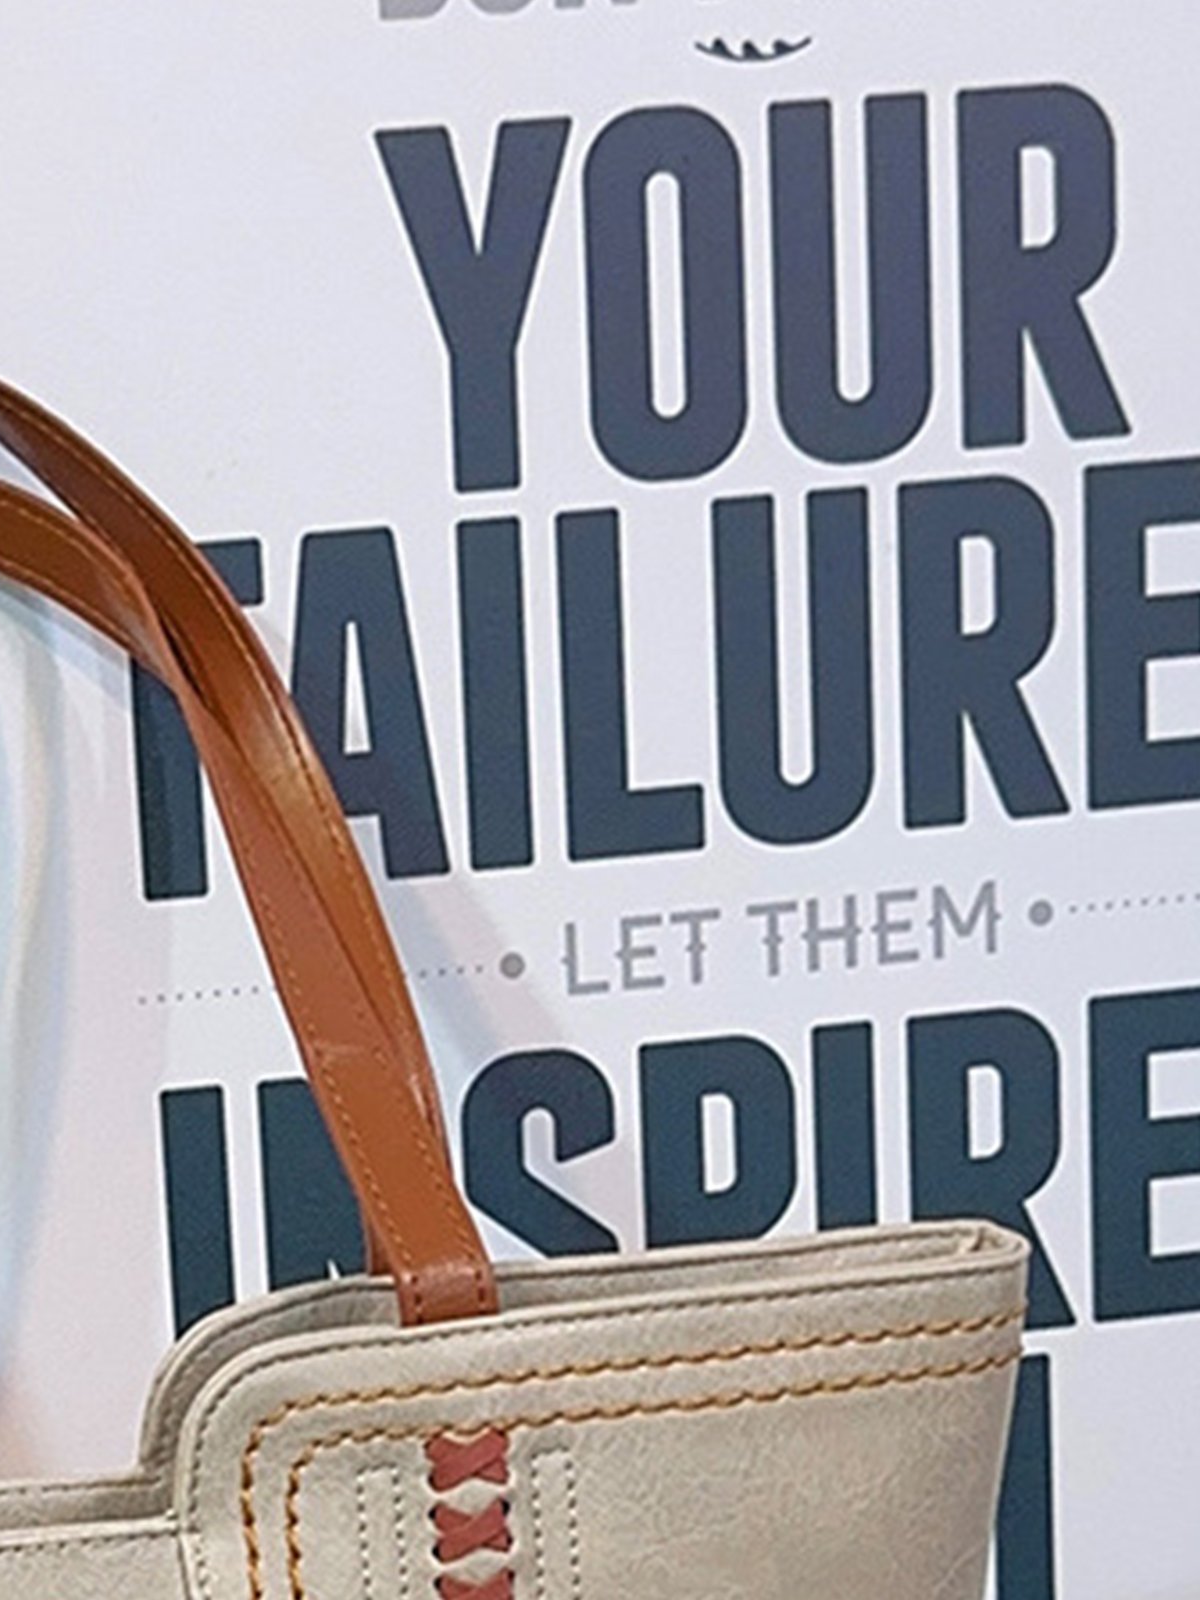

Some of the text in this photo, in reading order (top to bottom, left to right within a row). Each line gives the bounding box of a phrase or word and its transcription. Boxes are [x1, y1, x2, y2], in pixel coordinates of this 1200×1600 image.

[375, 82, 1132, 493] YOUR
[562, 880, 1001, 995] LET THEM
